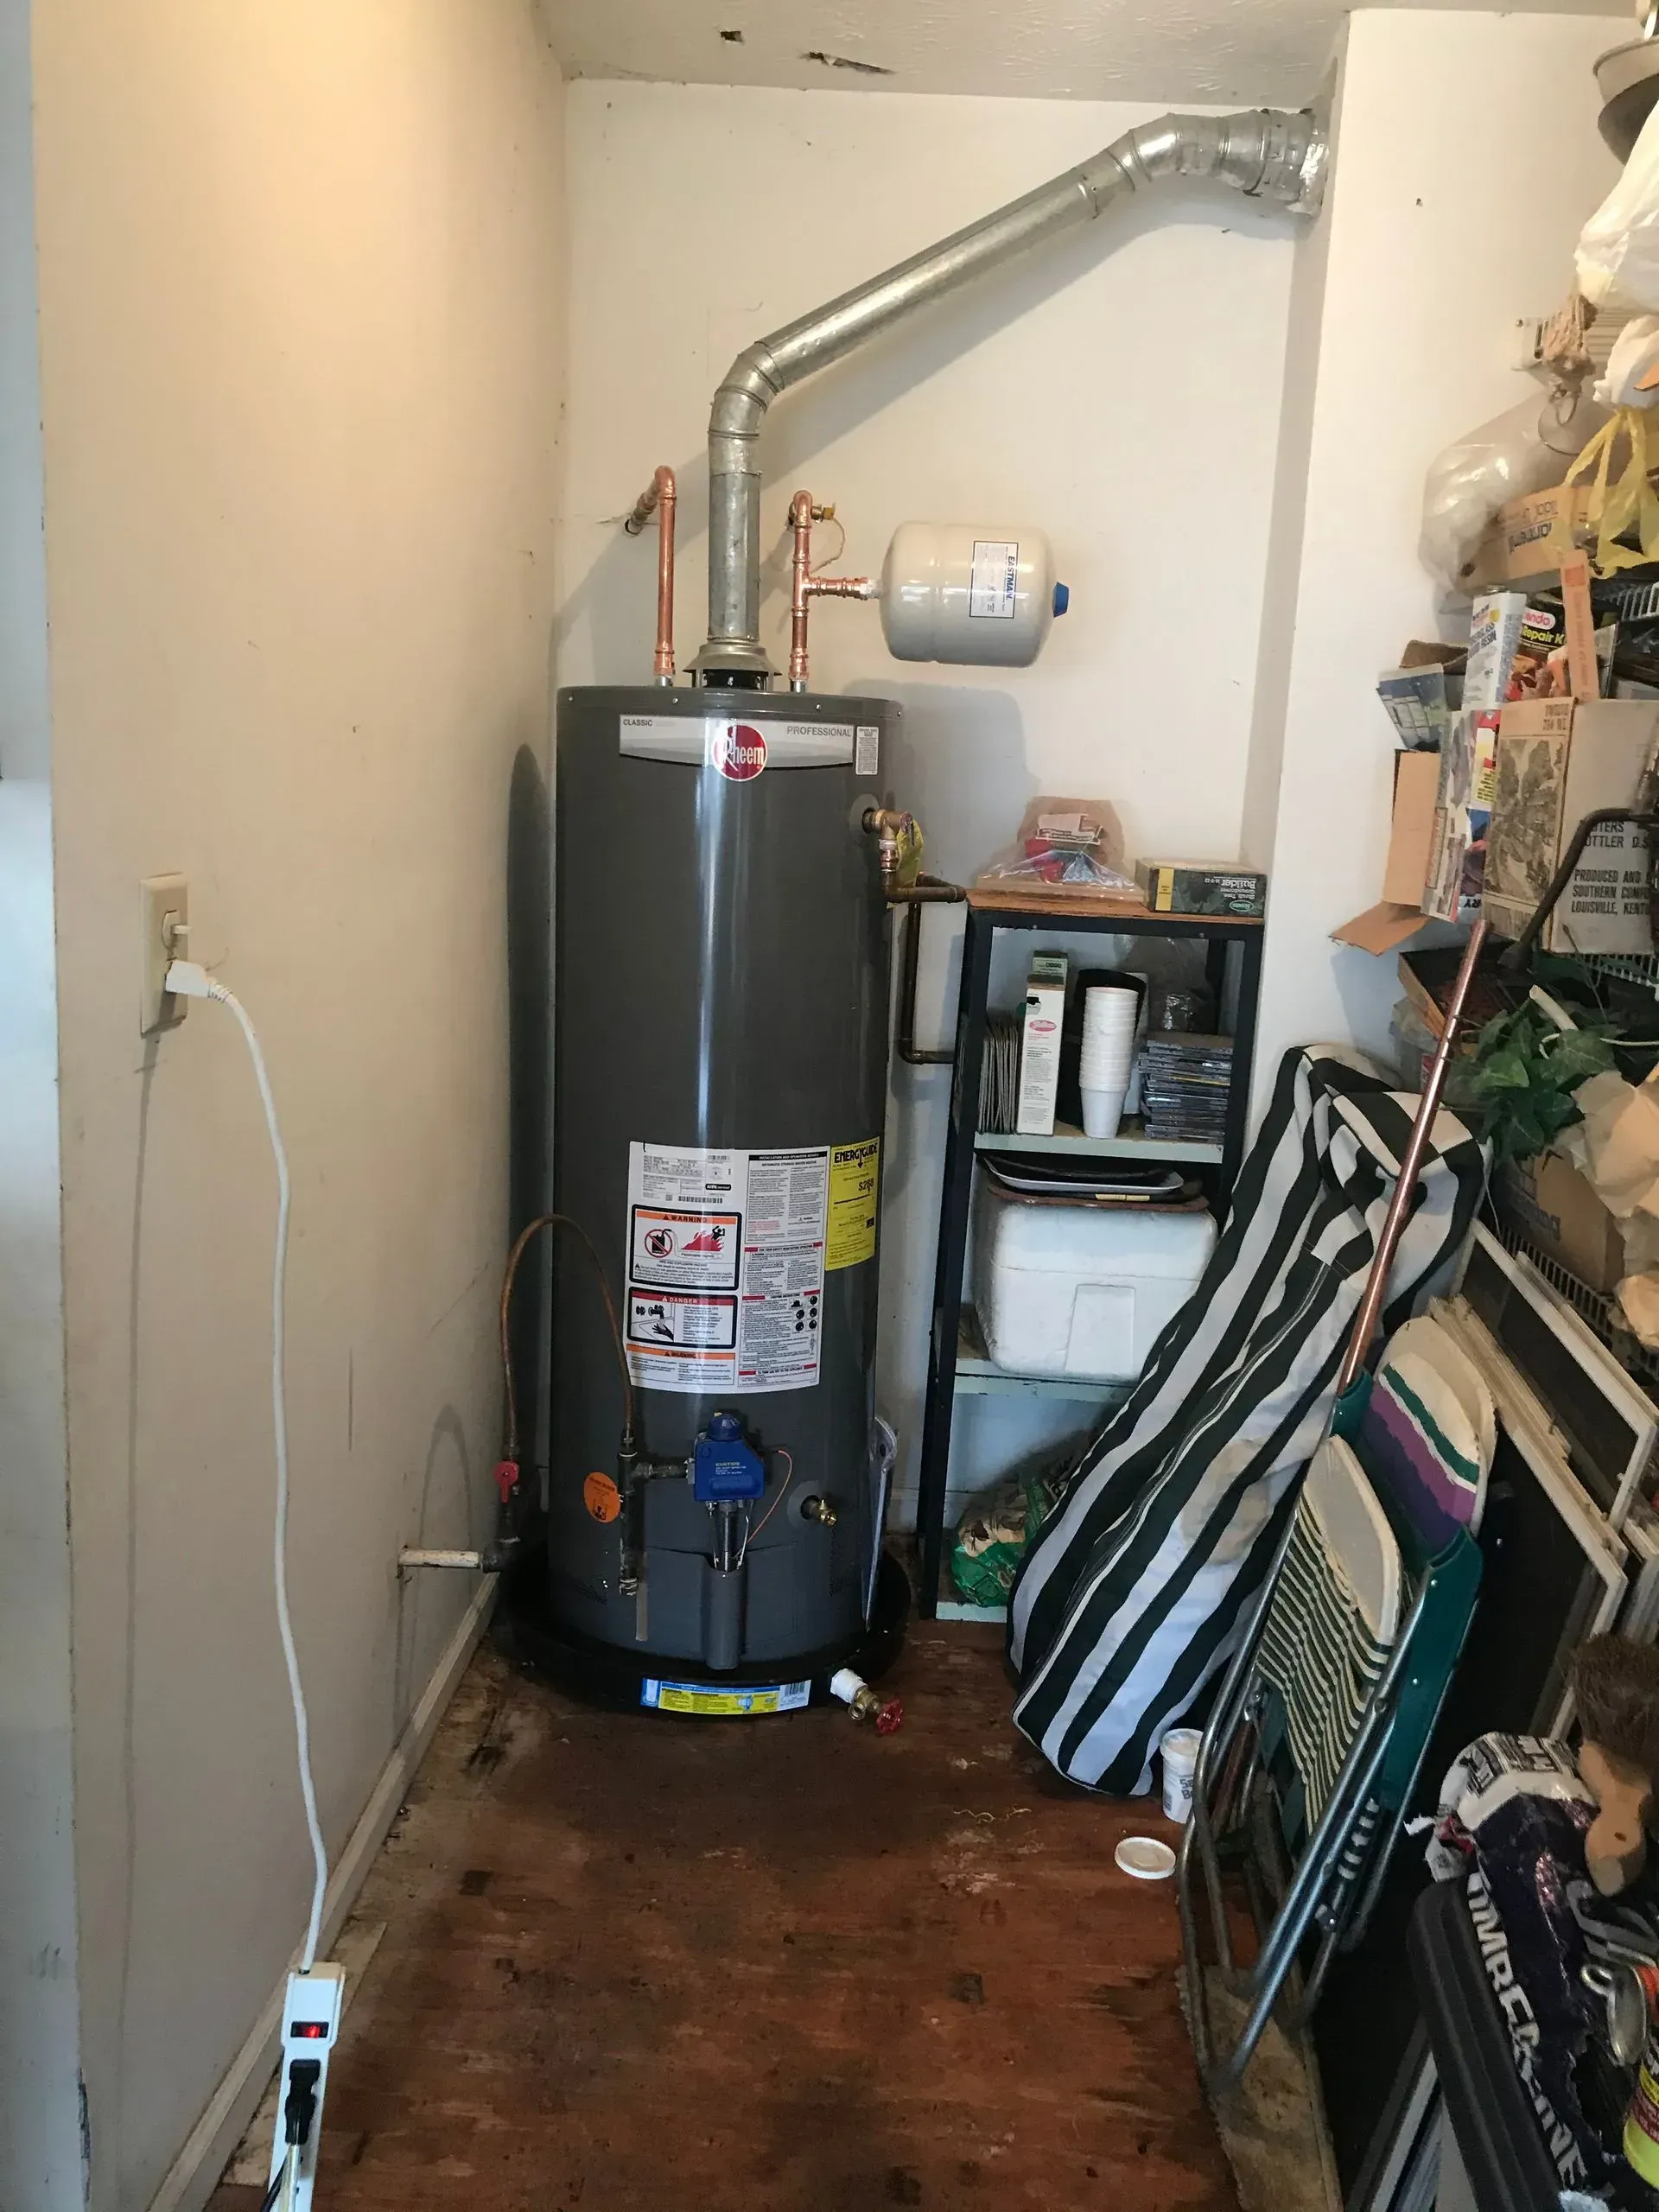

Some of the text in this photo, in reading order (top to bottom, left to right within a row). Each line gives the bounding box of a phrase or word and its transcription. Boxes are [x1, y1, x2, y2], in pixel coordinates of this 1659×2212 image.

[1006, 555, 1016, 600] EASTMAN
[623, 718, 653, 728] CLASSIC
[786, 726, 852, 738] PROFESSIONAL
[723, 736, 765, 771] Rheem
[1574, 868, 1618, 882] PRODUCED
[1221, 879, 1256, 889] Builder
[1573, 885, 1617, 899] SOUTHERN
[671, 1215, 708, 1224] WARNING
